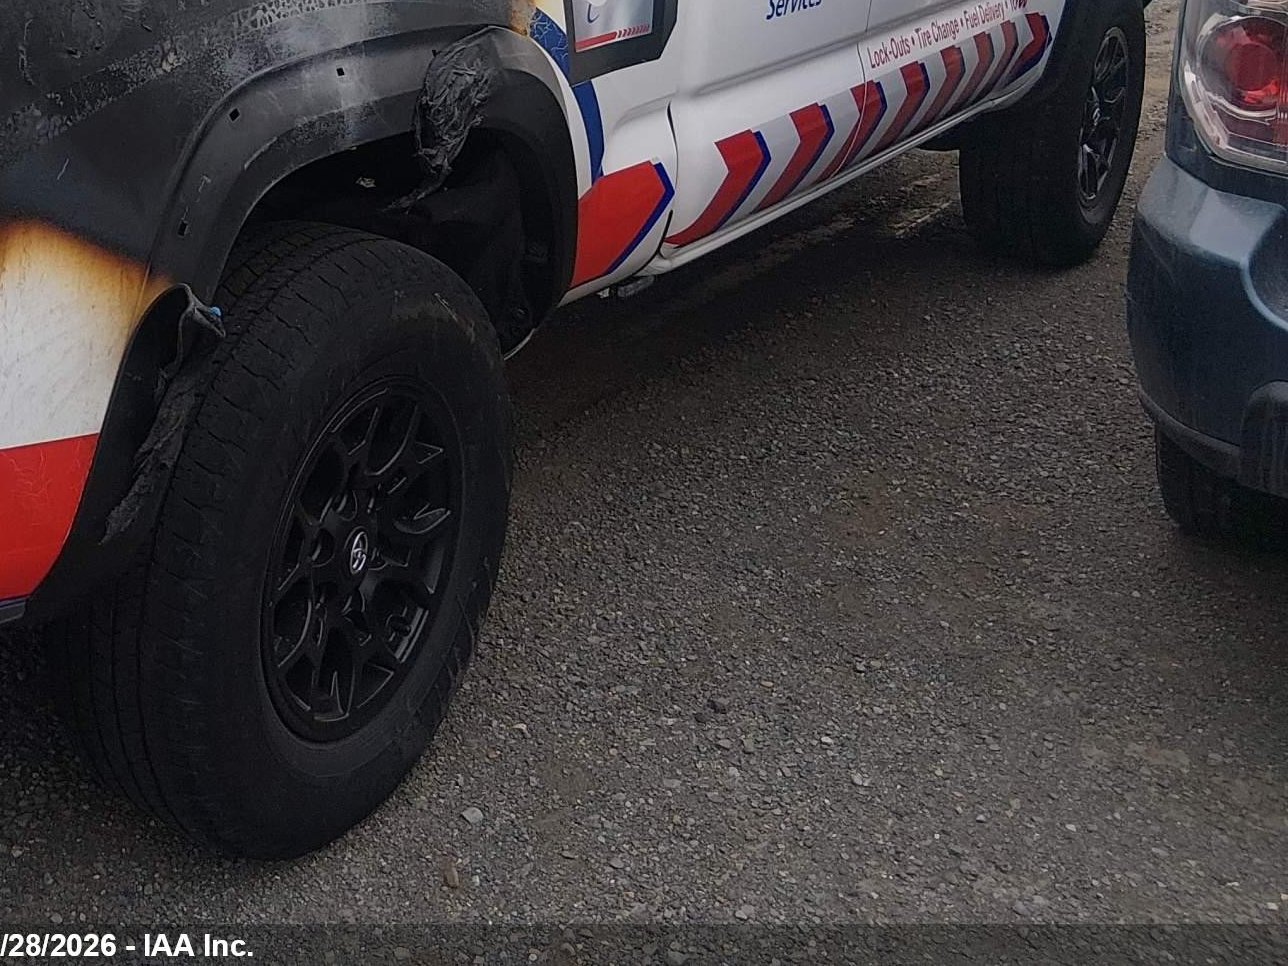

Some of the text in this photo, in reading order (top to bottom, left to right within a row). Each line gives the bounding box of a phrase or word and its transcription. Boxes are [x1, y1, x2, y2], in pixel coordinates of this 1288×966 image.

[867, 37, 911, 69] Lock-Outs
[914, 27, 931, 49] Tire
[931, 18, 960, 43] Change
[963, 7, 981, 31] Fuel
[980, 1, 1006, 23] Delivery
